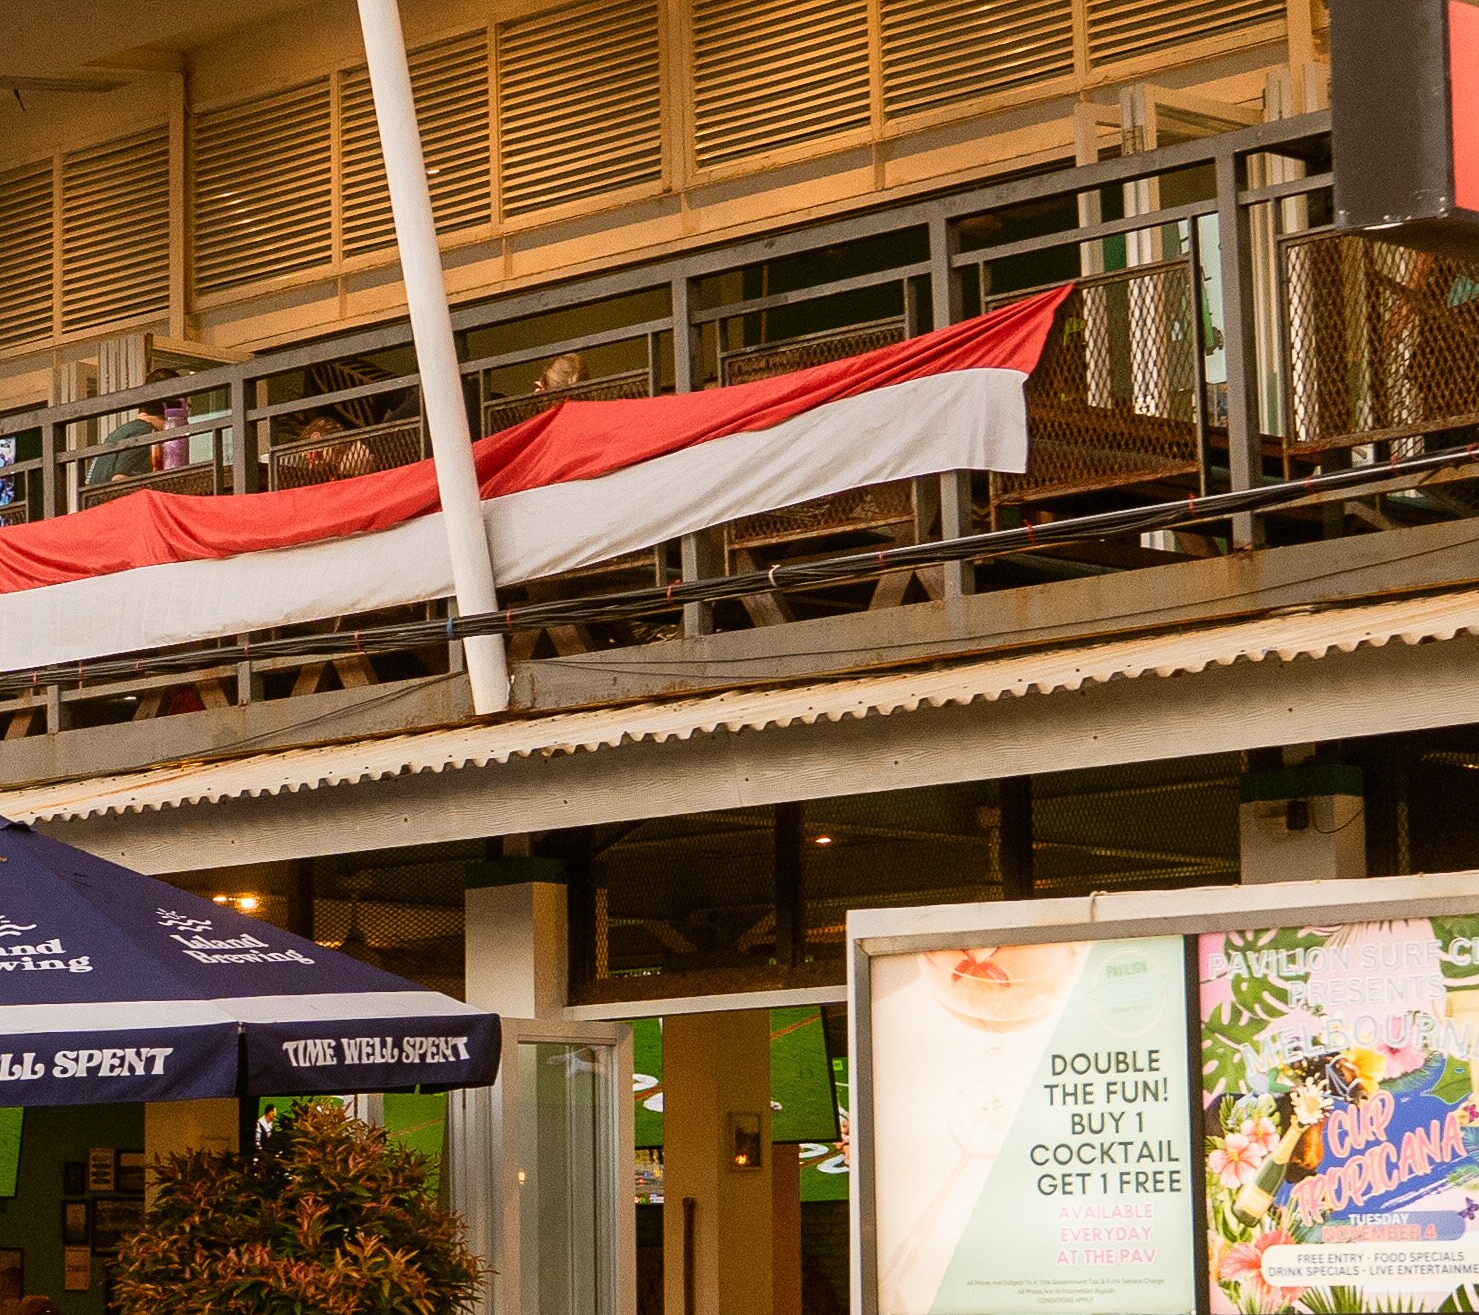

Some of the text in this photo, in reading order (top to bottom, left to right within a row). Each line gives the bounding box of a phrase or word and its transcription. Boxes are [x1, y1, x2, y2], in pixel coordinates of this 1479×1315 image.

[170, 933, 271, 952] Island
[182, 948, 316, 966] Brewing
[1208, 946, 1351, 980] PAVILION
[1360, 940, 1443, 970] SURF
[1287, 972, 1449, 1009] PRESENTS
[51, 1046, 174, 1079] SPENT
[281, 1035, 469, 1068] TIME WELL SPENT
[1050, 1049, 1161, 1077] DOUBLE
[1043, 1077, 1169, 1107] THE FUN!
[1070, 1111, 1144, 1136] BUY 1
[1327, 1089, 1396, 1159] CUP
[1029, 1139, 1181, 1167] COCKTAIL
[1290, 1111, 1469, 1228] TROPICANA
[1037, 1170, 1183, 1196] GET 1 FREE
[1058, 1203, 1154, 1222] AVAILABLE
[1348, 1213, 1411, 1226] TUESDAY
[1060, 1225, 1153, 1243] EVERYDAY
[1321, 1224, 1423, 1243] NOVEMBER
[1056, 1248, 1157, 1266] AT THE PAV
[1297, 1250, 1465, 1265] FREE ENTRY FOOD SPECIALS
[1268, 1265, 1304, 1278] DRINK
[1306, 1264, 1360, 1277] SPECIALS
[1369, 1264, 1395, 1276] LIVE
